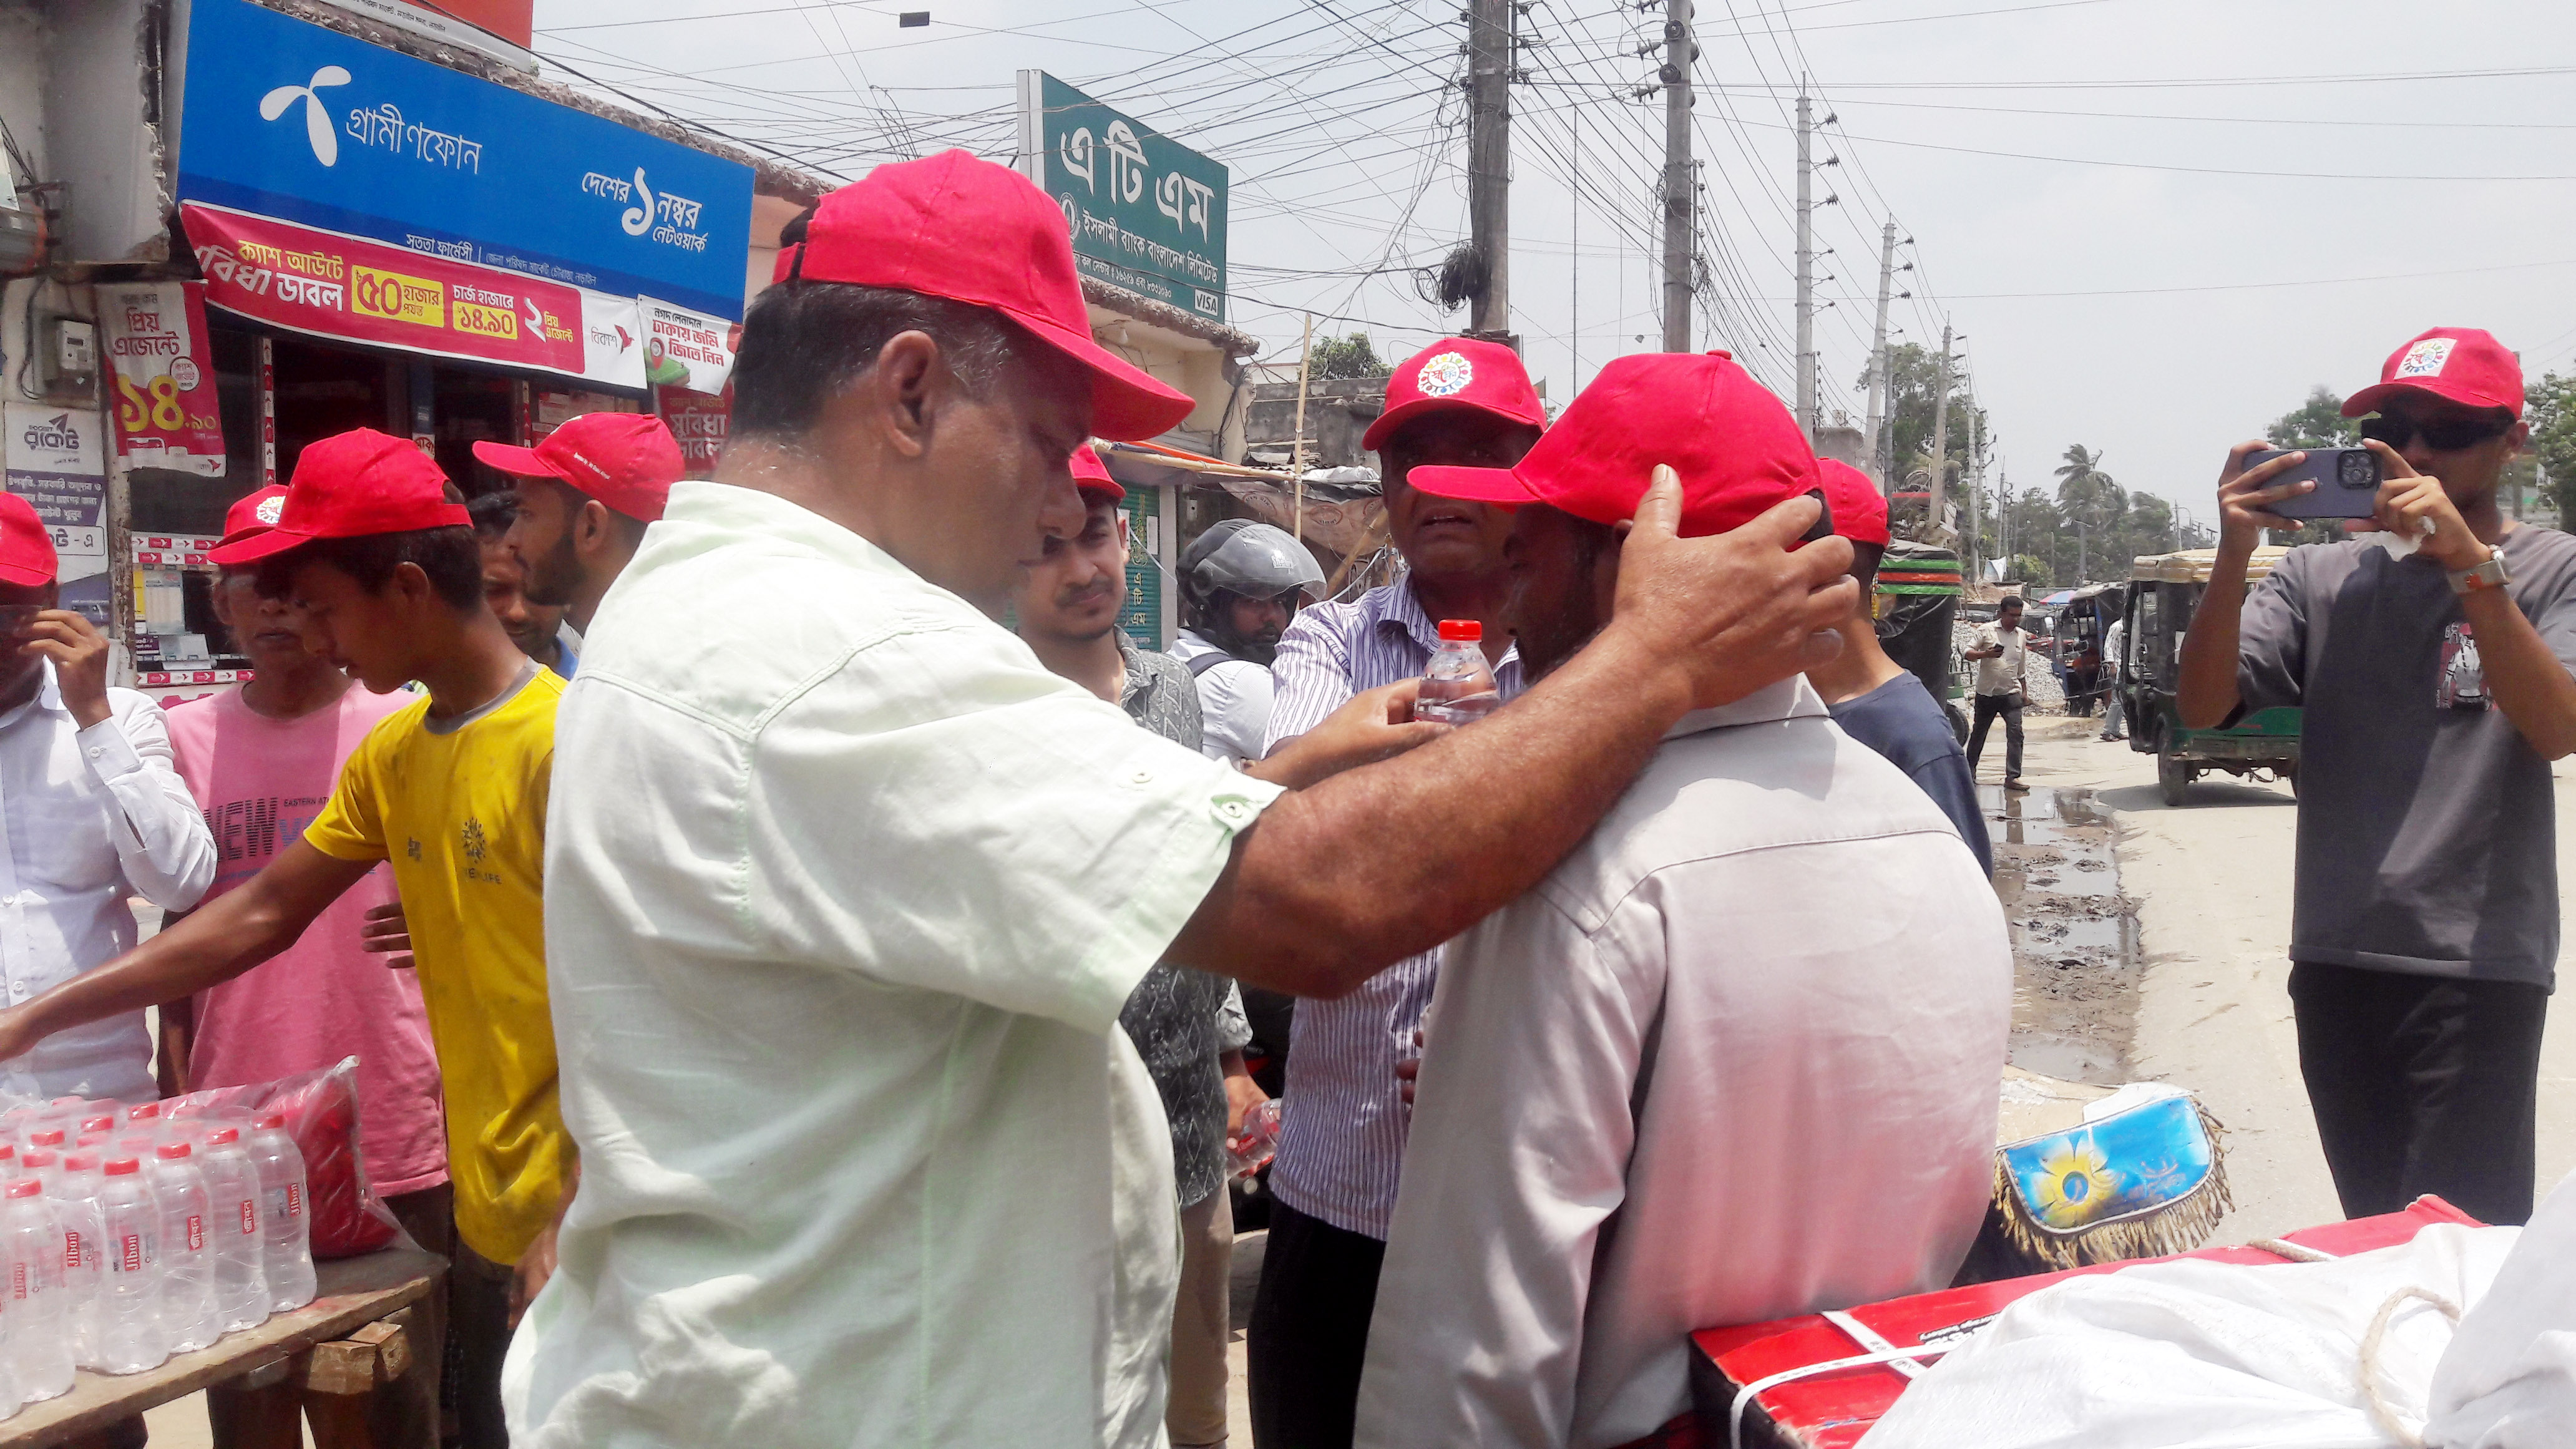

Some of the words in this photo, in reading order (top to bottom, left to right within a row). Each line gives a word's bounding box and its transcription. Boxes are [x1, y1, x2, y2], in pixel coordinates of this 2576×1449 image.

[1061, 127, 1094, 196] এ
[1102, 119, 1149, 205] টি
[1155, 170, 1215, 244] এম
[582, 171, 632, 204] দেশের
[622, 166, 655, 237] ১
[657, 192, 703, 230] নম্বর
[406, 234, 435, 253] সততা
[437, 241, 473, 261] ফার্মেসী
[652, 223, 709, 253] নেটওয়ার্ক
[1082, 207, 1118, 248] ইসলামী
[1120, 228, 1146, 258] ব্যাংক
[1146, 240, 1185, 273] বাংলাদেশ
[1186, 250, 1218, 283] লিমিটেড
[238, 240, 282, 268] ক্যাশ
[285, 251, 344, 280] আউটে
[1093, 260, 1110, 276] সেন্টার
[1136, 276, 1146, 290] এবং
[276, 272, 344, 311] ডাবল
[403, 285, 441, 306] হাজার
[452, 283, 476, 301] চার্জ
[478, 290, 514, 309] হাজারে
[1196, 293, 1217, 313] VISA
[127, 306, 160, 333] প্রিয়
[524, 297, 547, 343] ২
[654, 308, 671, 321] নগদ
[591, 326, 617, 348] বিকাশ
[692, 329, 720, 348] জমি
[668, 338, 701, 361] জিতে
[702, 346, 724, 367] নিন
[669, 407, 726, 438] সুবিধা
[284, 797, 316, 807] EASTERN
[126, 1234, 139, 1270] Jibon
